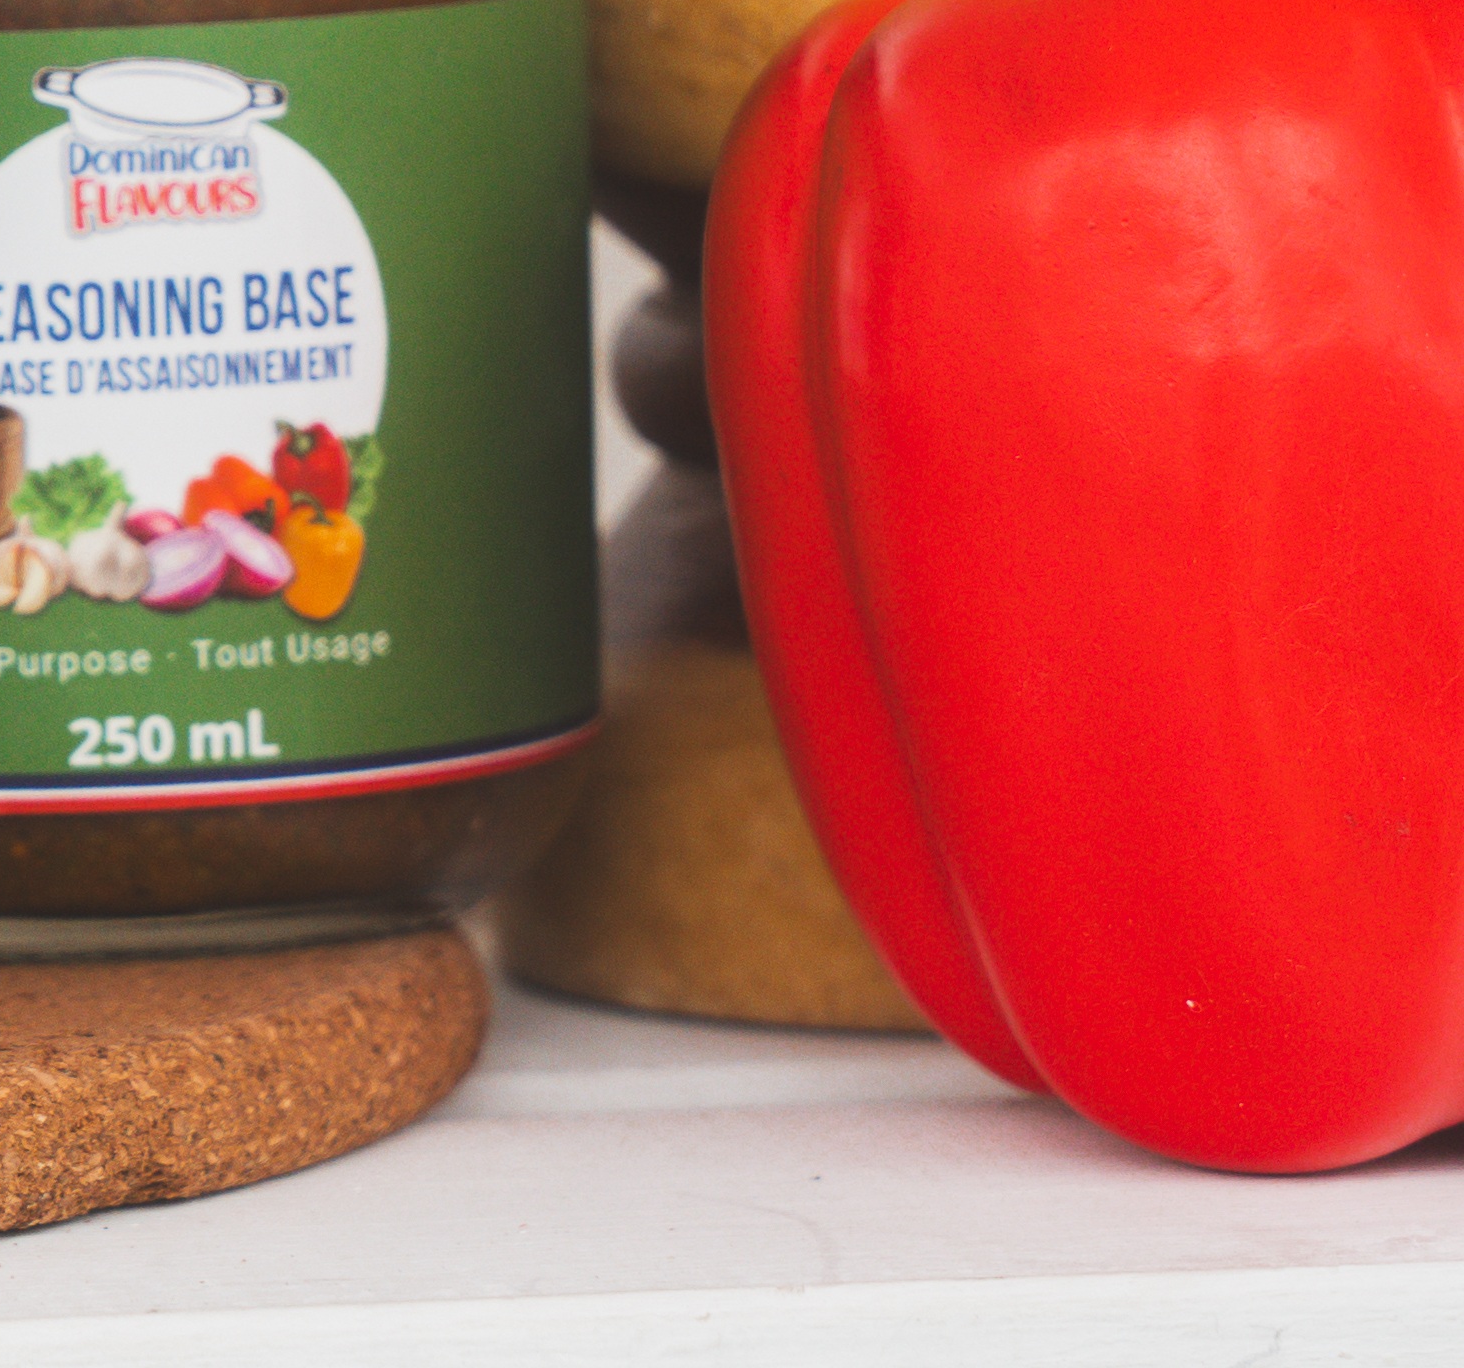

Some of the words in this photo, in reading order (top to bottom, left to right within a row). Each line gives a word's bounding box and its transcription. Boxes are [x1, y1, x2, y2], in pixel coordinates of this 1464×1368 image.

[72, 176, 257, 232] FLAVOURS
[246, 266, 356, 331] BASE
[68, 343, 353, 393] D'ASSAISONNEMENT
[191, 637, 274, 669] Tout
[287, 626, 392, 665] Usage
[69, 715, 174, 766] 250
[189, 709, 280, 761] mL
